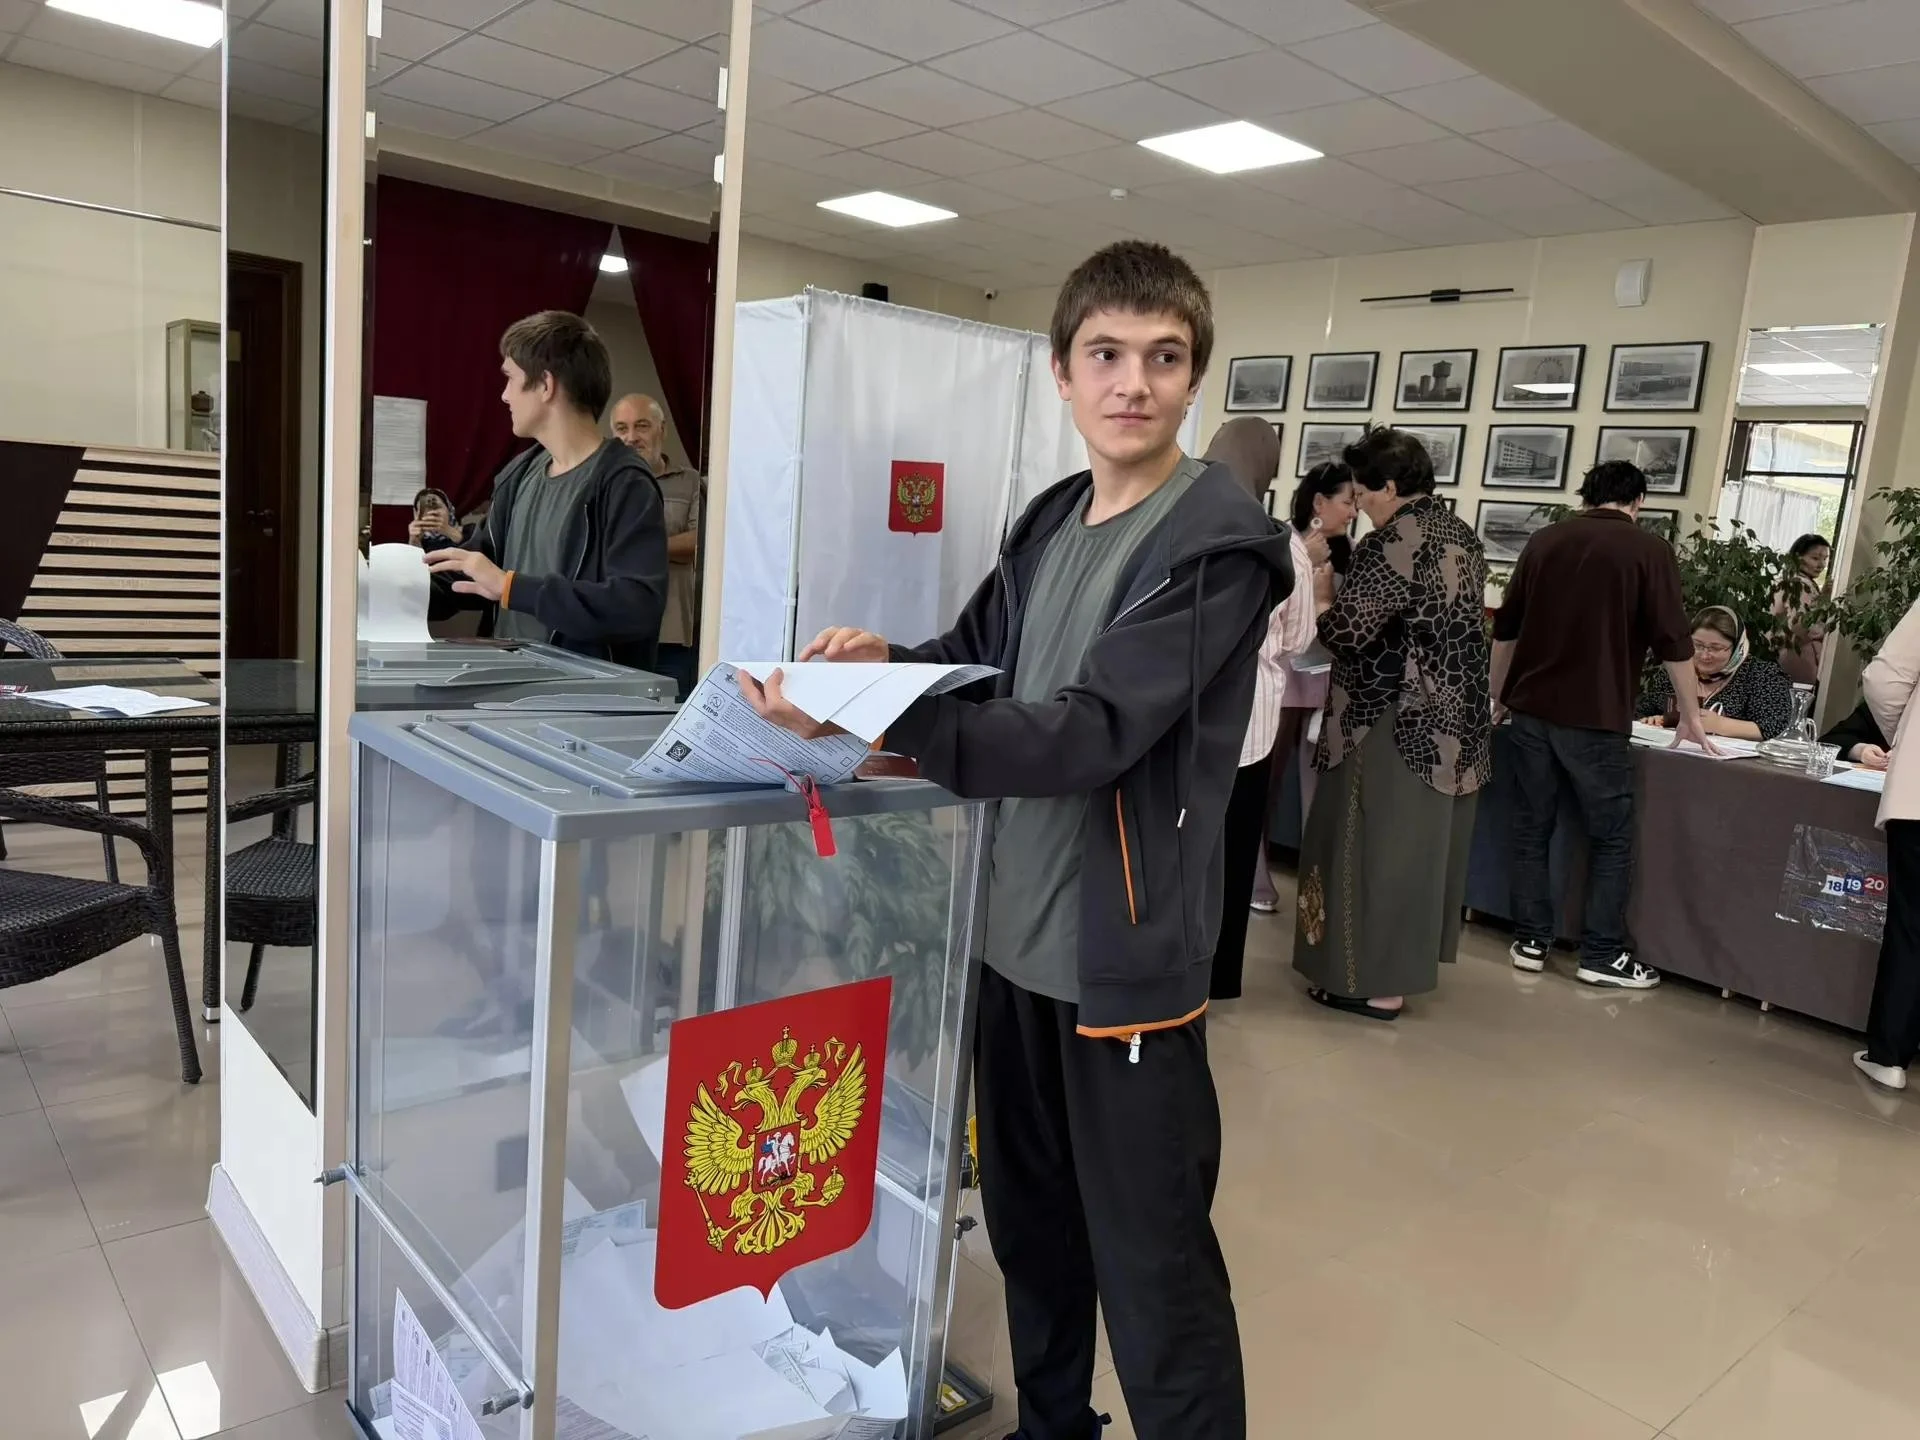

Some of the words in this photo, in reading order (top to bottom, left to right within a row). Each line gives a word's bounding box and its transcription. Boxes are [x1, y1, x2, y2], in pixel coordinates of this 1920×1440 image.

[1827, 880, 1842, 892] 18
[1845, 878, 1862, 891] 19
[1864, 877, 1885, 891] 20
